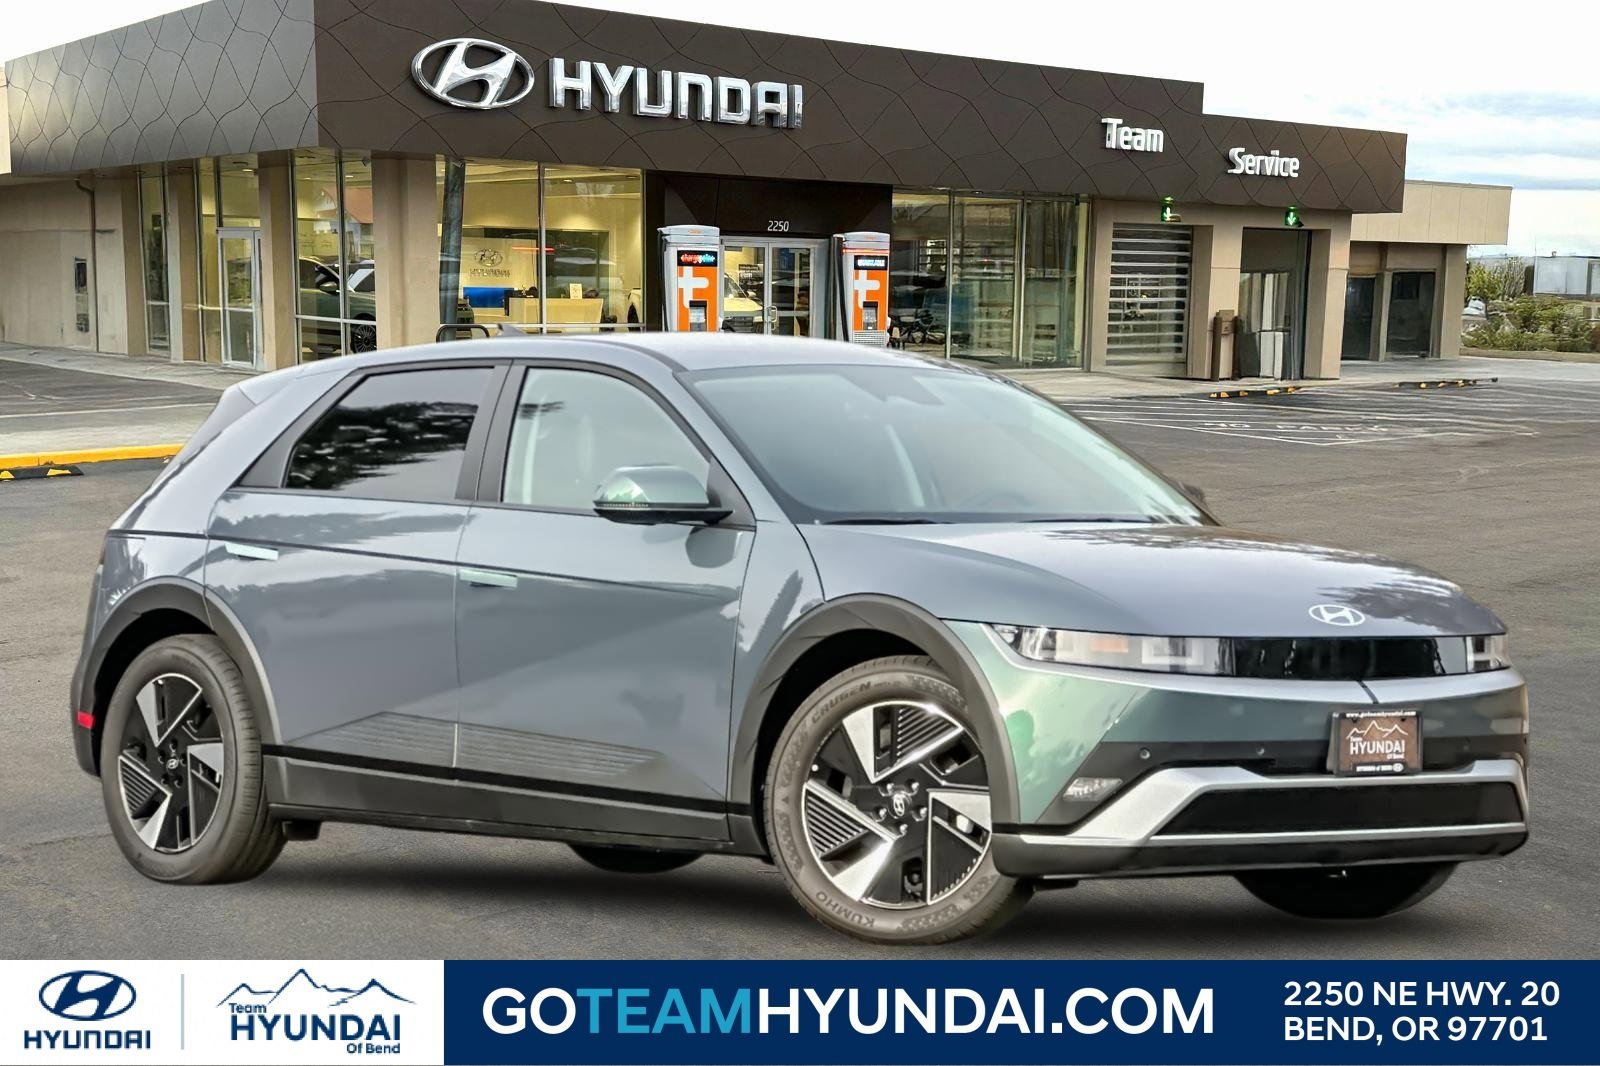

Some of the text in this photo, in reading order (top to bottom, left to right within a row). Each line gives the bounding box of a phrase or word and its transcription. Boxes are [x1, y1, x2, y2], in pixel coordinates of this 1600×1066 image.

[549, 58, 803, 129] HYUNDAI
[1101, 117, 1164, 153] Team
[1228, 147, 1300, 178] Service
[767, 220, 790, 232] 2250
[1349, 740, 1406, 755] HYUNDAI
[815, 890, 876, 928] KUMHO
